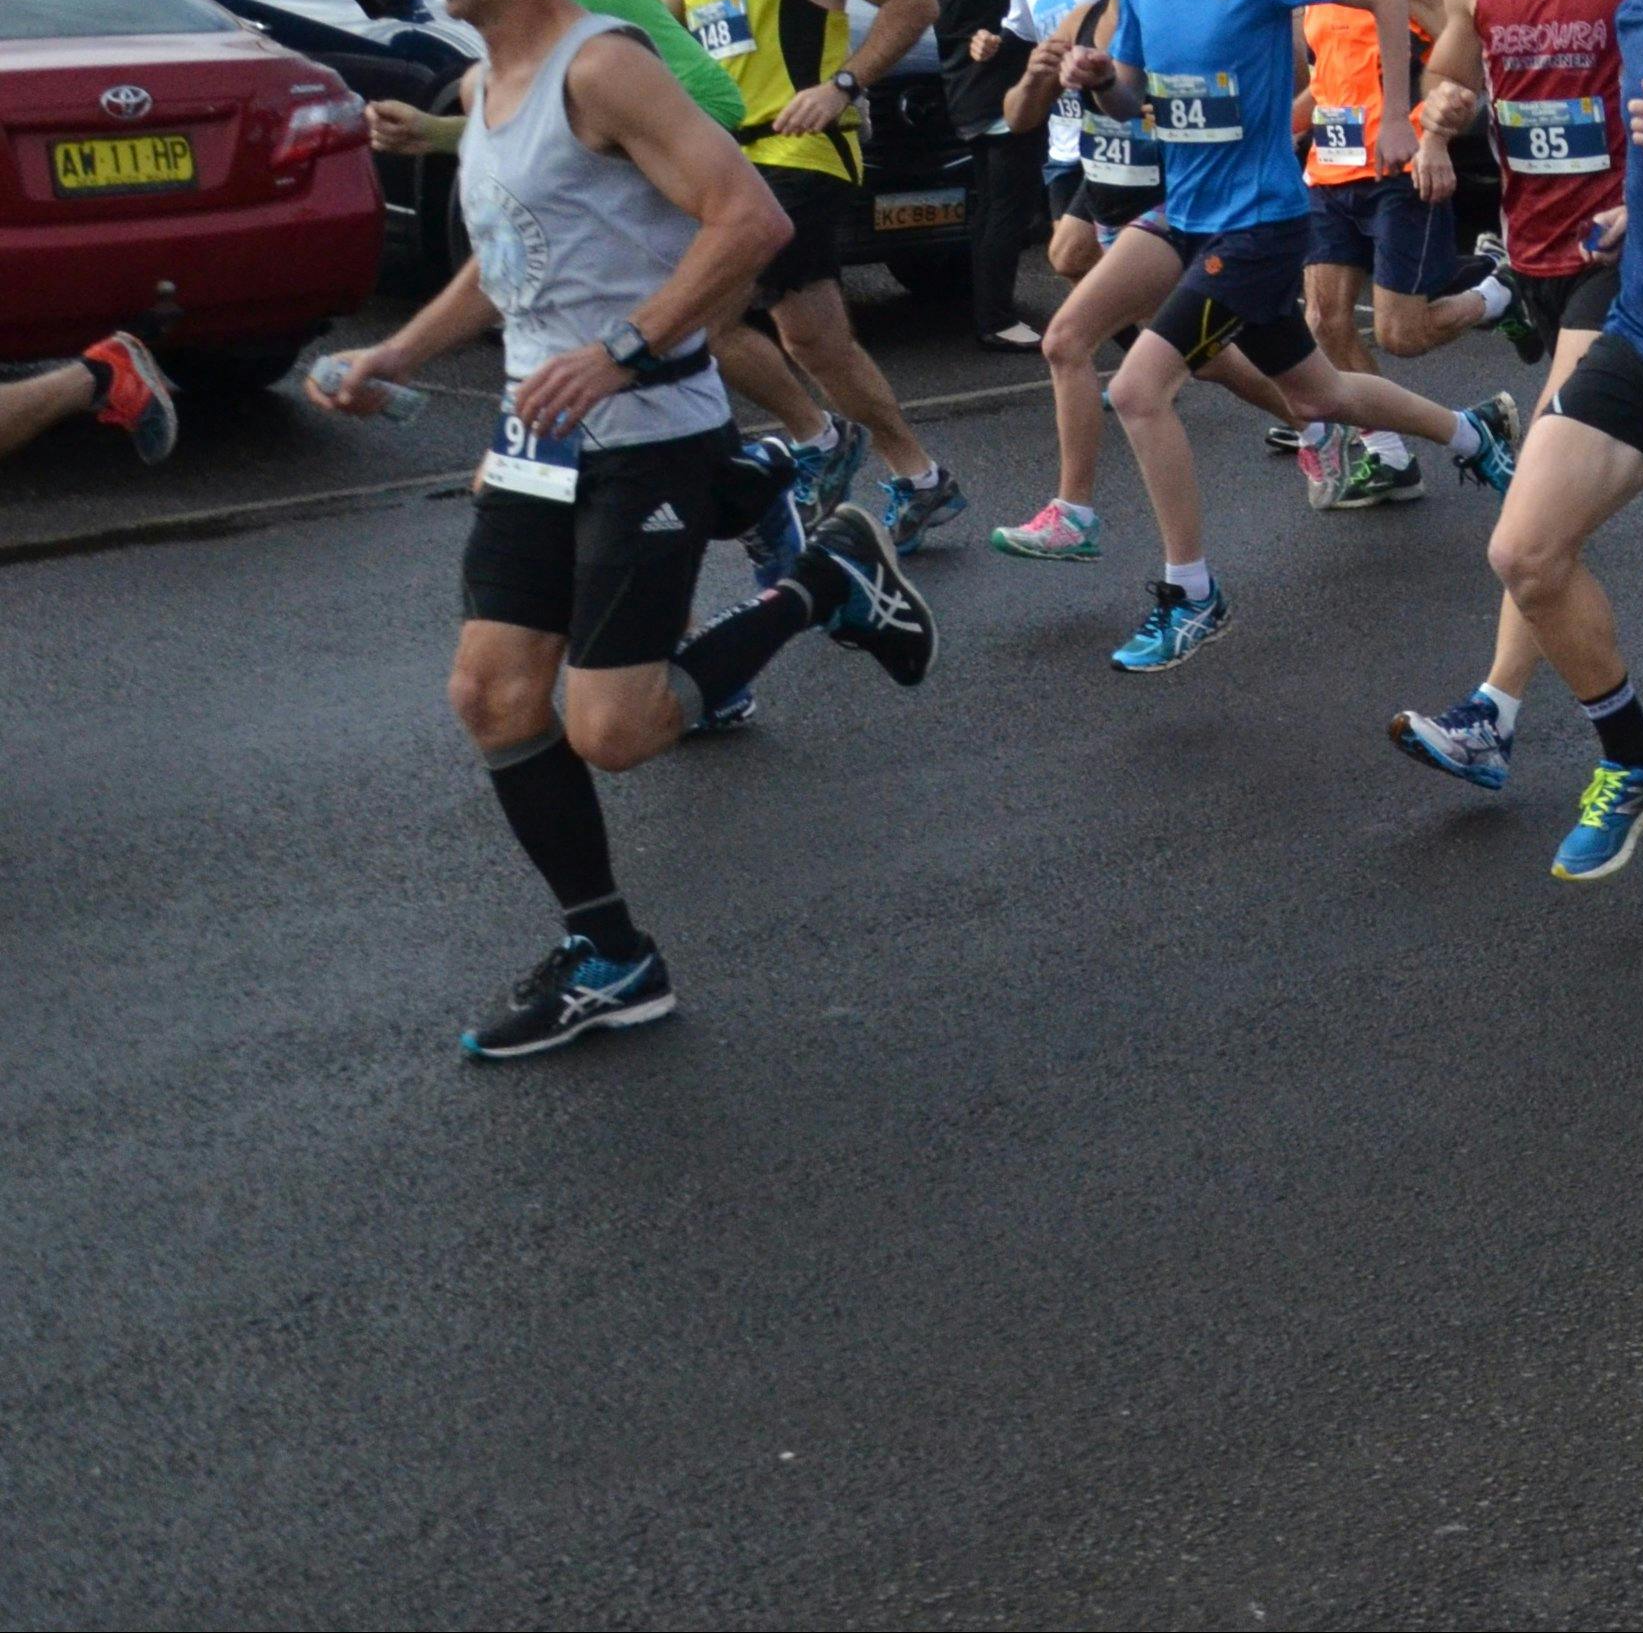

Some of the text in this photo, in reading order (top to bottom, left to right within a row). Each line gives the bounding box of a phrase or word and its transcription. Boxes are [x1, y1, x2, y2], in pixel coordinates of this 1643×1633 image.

[699, 20, 731, 50] 148
[1490, 19, 1607, 55] BEROWRA
[1056, 98, 1082, 118] 139
[1170, 98, 1206, 129] 84
[1093, 136, 1131, 165] 241
[1326, 125, 1346, 147] 53
[1529, 126, 1569, 159] 85
